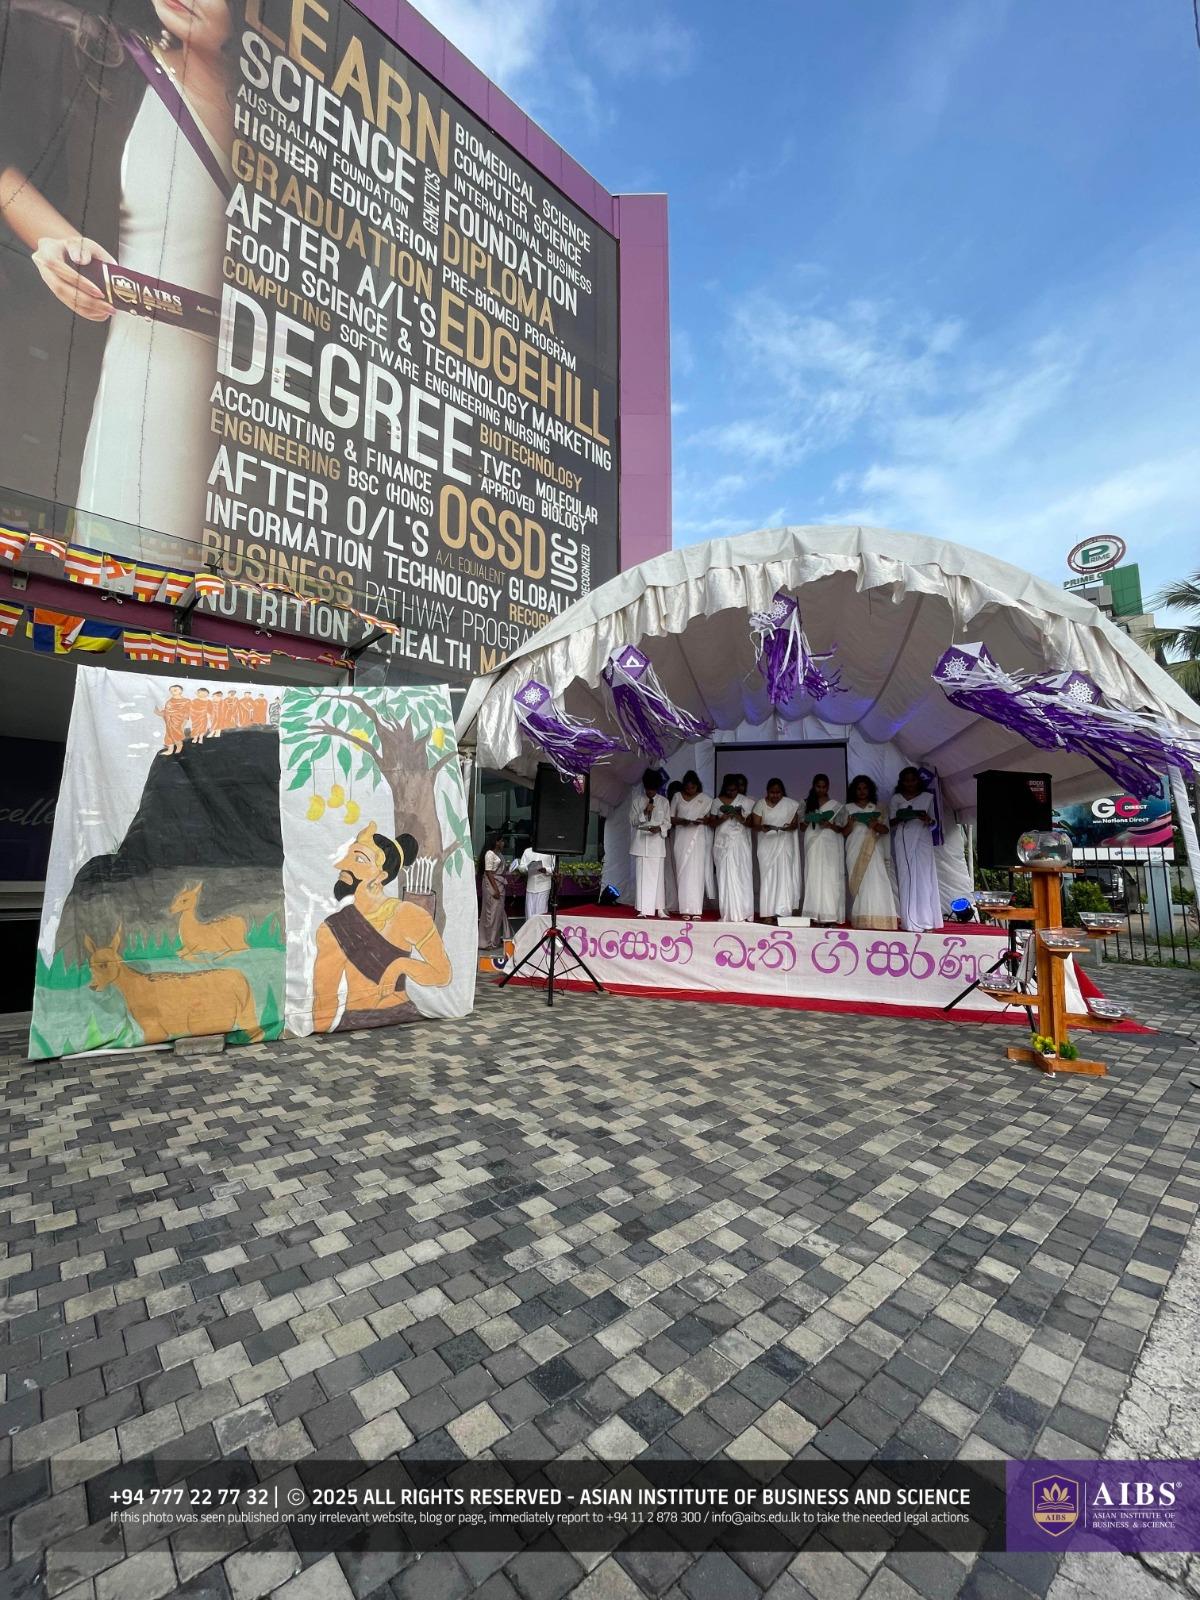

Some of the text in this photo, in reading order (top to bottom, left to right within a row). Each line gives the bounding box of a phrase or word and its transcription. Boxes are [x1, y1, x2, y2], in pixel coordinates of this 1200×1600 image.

[240, 31, 416, 203] SCIENCE
[245, 0, 449, 178] LEARN
[234, 103, 437, 266] HIGHER EDUCATION
[237, 84, 408, 219] AUSTRALIAN FOUNDATION
[422, 167, 441, 236] GENETICS
[456, 122, 590, 253] BIOMEDICAL SCIENCE
[225, 183, 340, 282] AFTER
[231, 139, 433, 301] GRADUATION
[445, 189, 577, 317] FOUNDATION
[454, 148, 582, 267] COMPUTER SCIENCE
[454, 173, 592, 295] INTERNATIONAL BUSINESS
[222, 255, 331, 332] COMPUTING
[442, 265, 576, 372] PRE-BIOMED PROGRAM
[443, 222, 555, 335] DIPLOMA
[217, 282, 474, 485] DEGREE
[225, 223, 612, 471] FOOD SCIENCE & TECHNOLOGY MARKETING
[340, 323, 550, 455] SOFTWARE ENGINEERING NURSING
[440, 287, 610, 447] EDGEHILL
[207, 444, 329, 525] AFTER
[209, 381, 432, 494] ACCOUNTING & FINANCE
[210, 408, 434, 517] ENGINEERING BSC (HONS)
[480, 422, 583, 493] BIOTECHNOLOGY
[480, 450, 521, 490] TVEC
[439, 484, 546, 579] OSSD
[480, 476, 535, 514] APPROVED
[535, 478, 598, 525] MOLECULAR
[541, 499, 587, 535] BIOLOGY
[203, 528, 537, 650] BUSINESS PATHWAY PROGRA
[205, 491, 502, 612] INFORMATION TECHNOLOGY
[436, 550, 455, 570] A/L
[509, 576, 577, 615] GLOBALL
[551, 532, 578, 592] UGC
[1064, 574, 1094, 587] PRIME
[197, 585, 349, 642] NUTRITION
[391, 624, 472, 672] HEALTH
